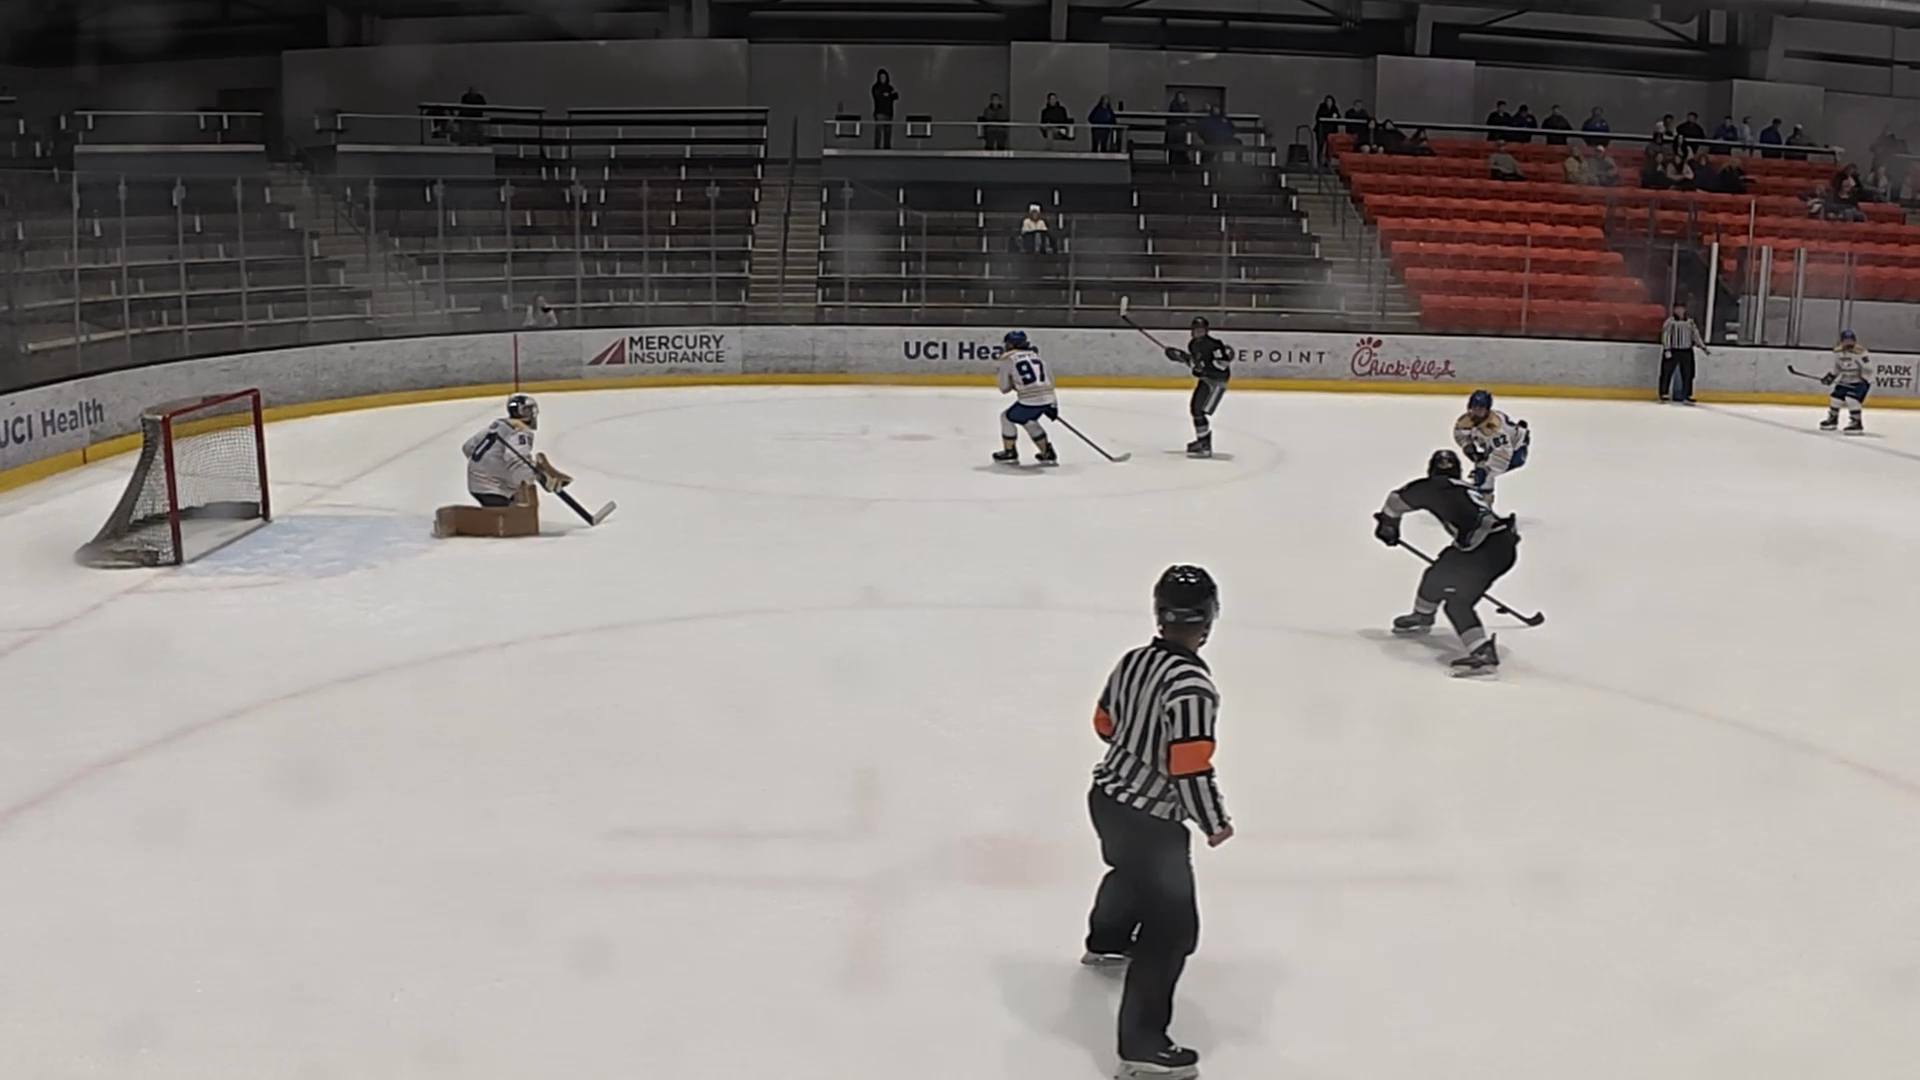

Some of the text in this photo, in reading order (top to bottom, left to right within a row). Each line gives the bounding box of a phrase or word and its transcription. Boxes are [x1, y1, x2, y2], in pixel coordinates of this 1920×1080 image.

[628, 334, 725, 350] MERCURY
[628, 350, 726, 364] INSURANCE
[903, 341, 948, 360] UCI
[957, 341, 1005, 360] Hea
[1238, 349, 1327, 364] EPOINT
[1015, 358, 1046, 385] 97
[1877, 364, 1912, 376] PARK
[1875, 376, 1912, 388] WEST
[41, 398, 104, 437] Health
